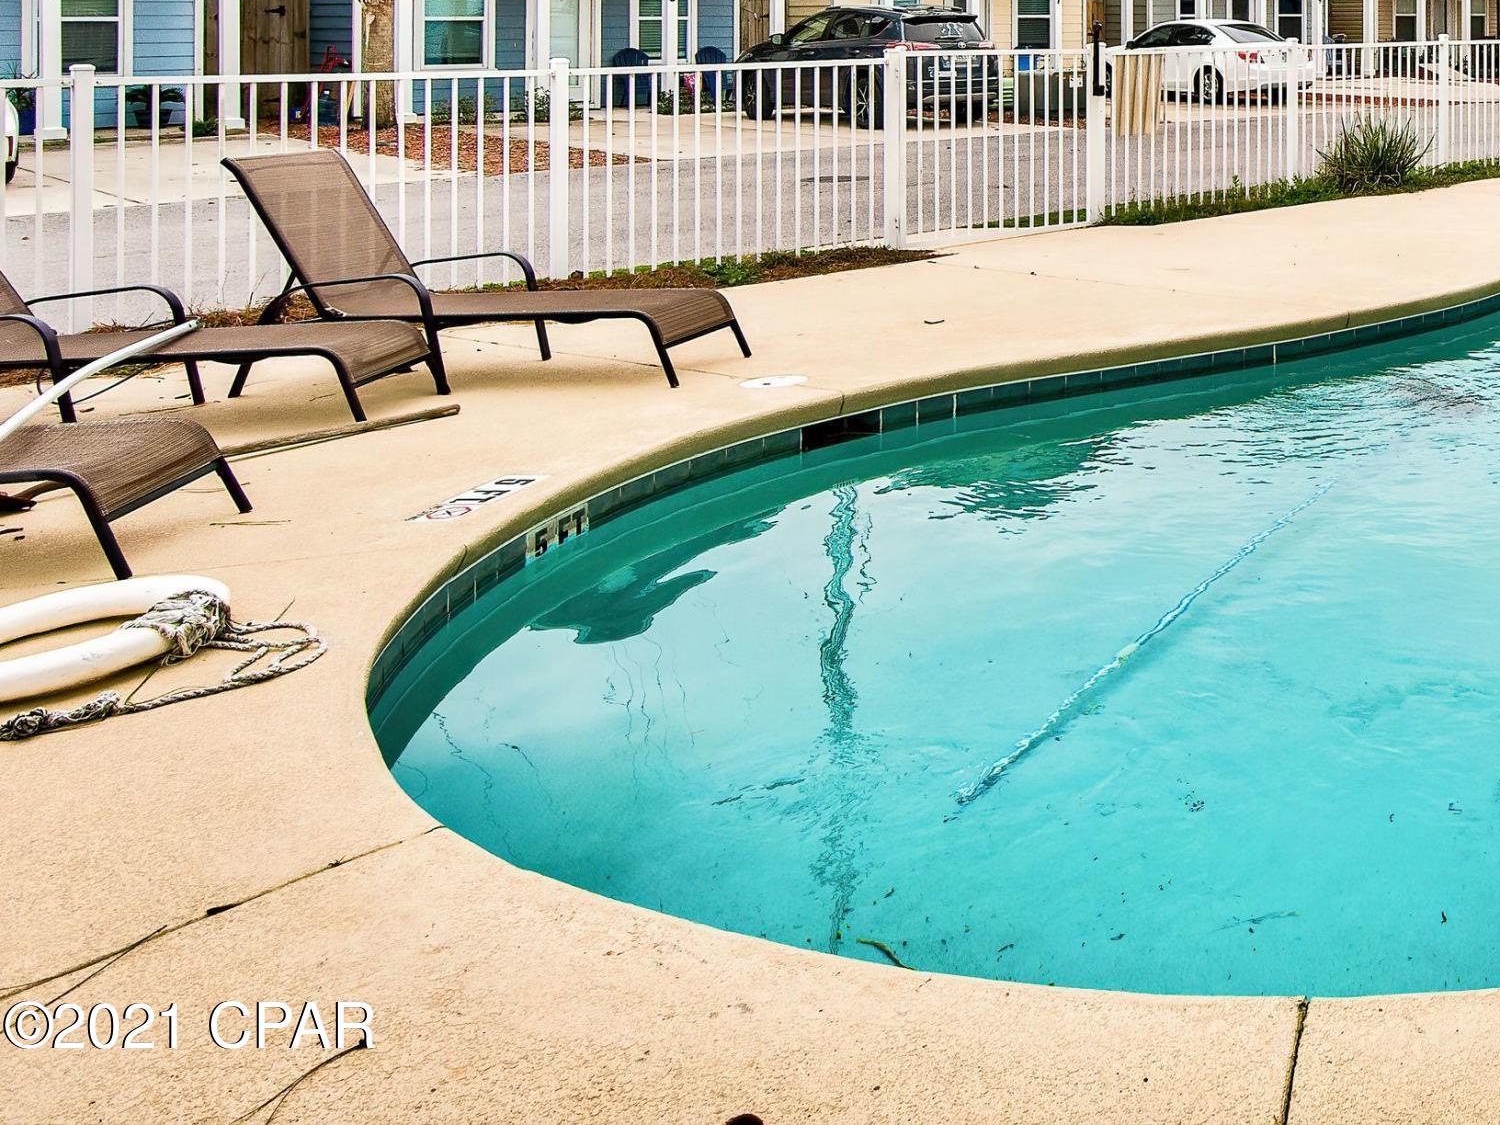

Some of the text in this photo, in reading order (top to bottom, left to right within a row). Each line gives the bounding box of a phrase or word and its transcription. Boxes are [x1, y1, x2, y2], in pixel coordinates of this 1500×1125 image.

[449, 489, 512, 503] FT
[534, 507, 585, 558] 5 FT
